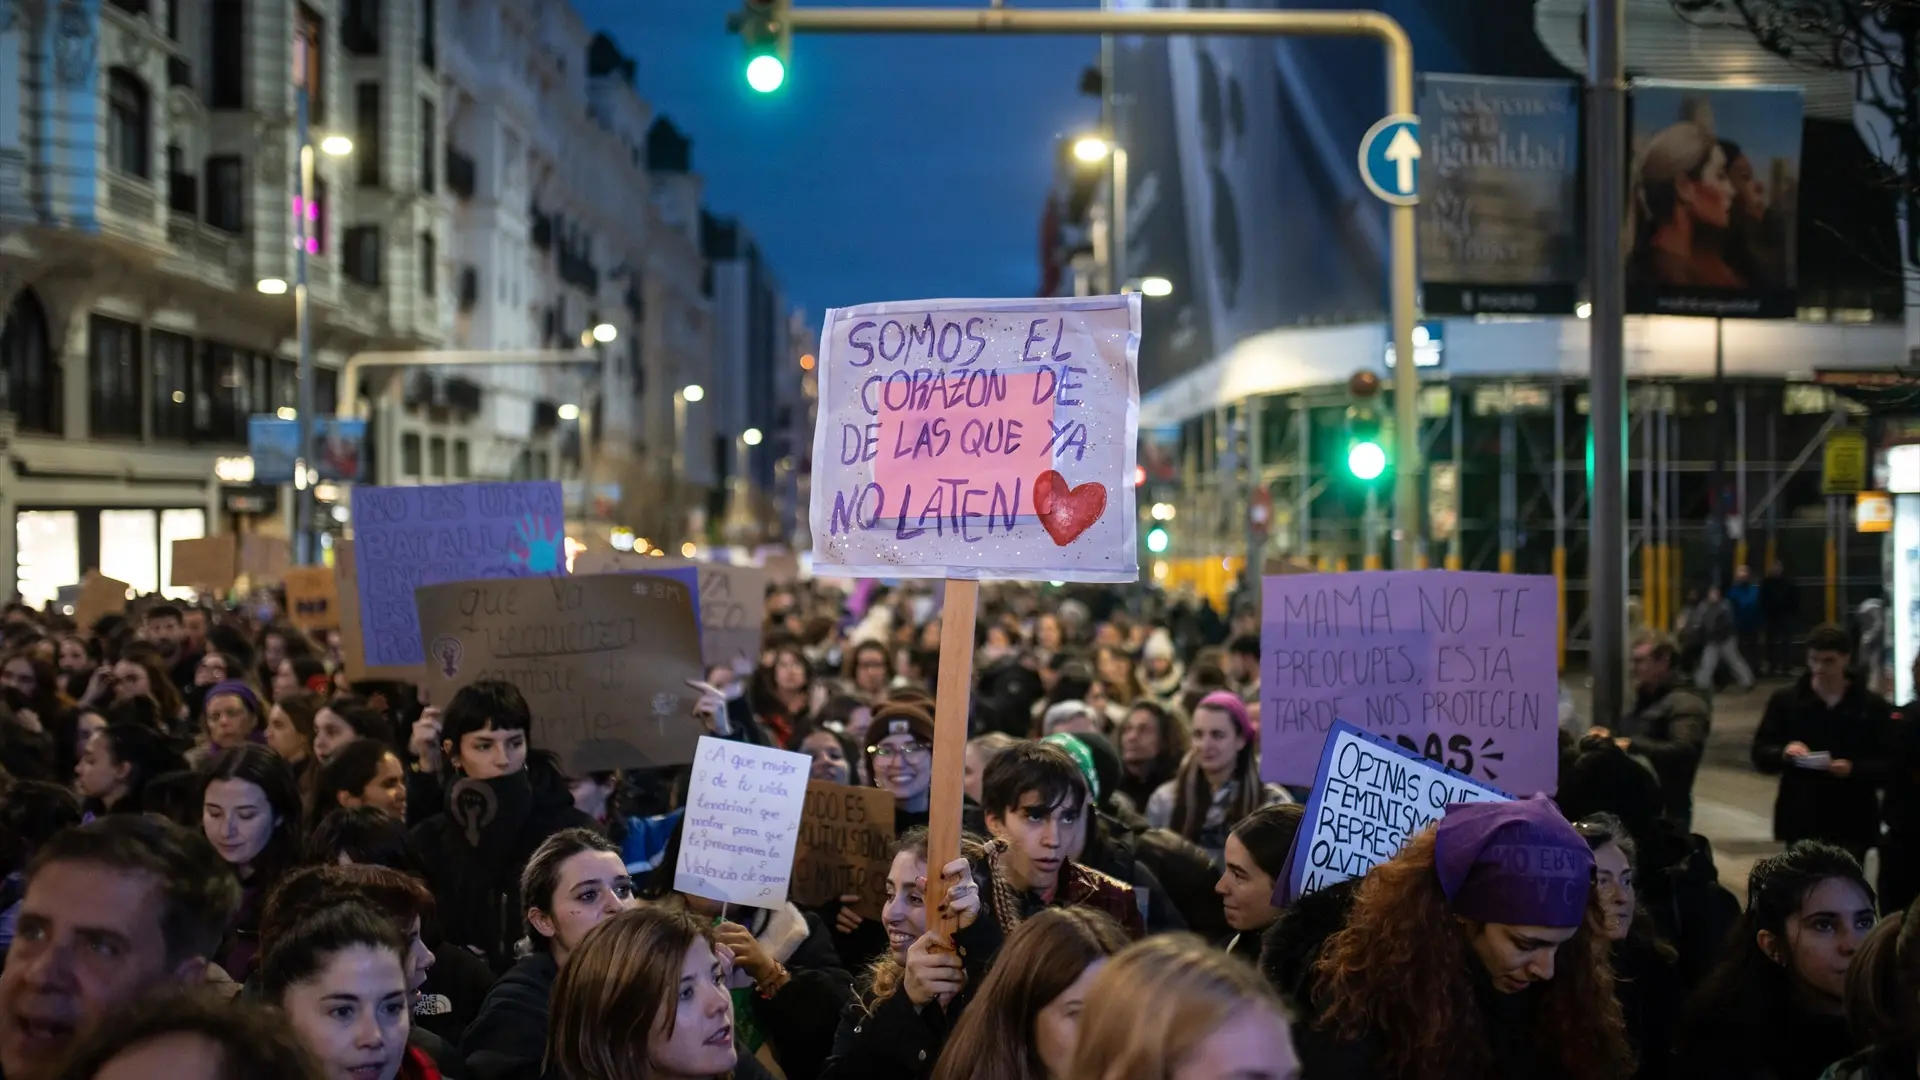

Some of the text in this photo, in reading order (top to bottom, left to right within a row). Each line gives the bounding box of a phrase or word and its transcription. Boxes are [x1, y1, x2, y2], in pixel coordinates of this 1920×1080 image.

[849, 314, 1071, 366] SOMOS EL
[862, 365, 1087, 415] CORAZON DE
[841, 418, 1087, 465] DE LAS QUE YA
[356, 484, 560, 526] NO ES UNA
[830, 477, 1020, 542] NO LATEN
[459, 586, 518, 633] que
[1283, 579, 1531, 639] MAMÁ NO TE
[1274, 645, 1514, 688] PREOCUPES, ESTA
[1366, 691, 1411, 728] NOS
[1422, 690, 1540, 731] PROTEGEN
[762, 760, 798, 776] mujer
[1338, 742, 1420, 801] OPINAS
[1380, 732, 1473, 775] DAS
[712, 772, 789, 797] de tu vida
[760, 808, 781, 824] que
[805, 790, 866, 823] ODO ES
[689, 833, 700, 847] te
[768, 846, 781, 859] la
[690, 815, 784, 844] matar para que
[802, 821, 847, 856] OLITICA
[684, 852, 738, 882] Violencia
[741, 868, 758, 883] de
[415, 1001, 436, 1009] ORTH
[421, 994, 436, 1002] THE
